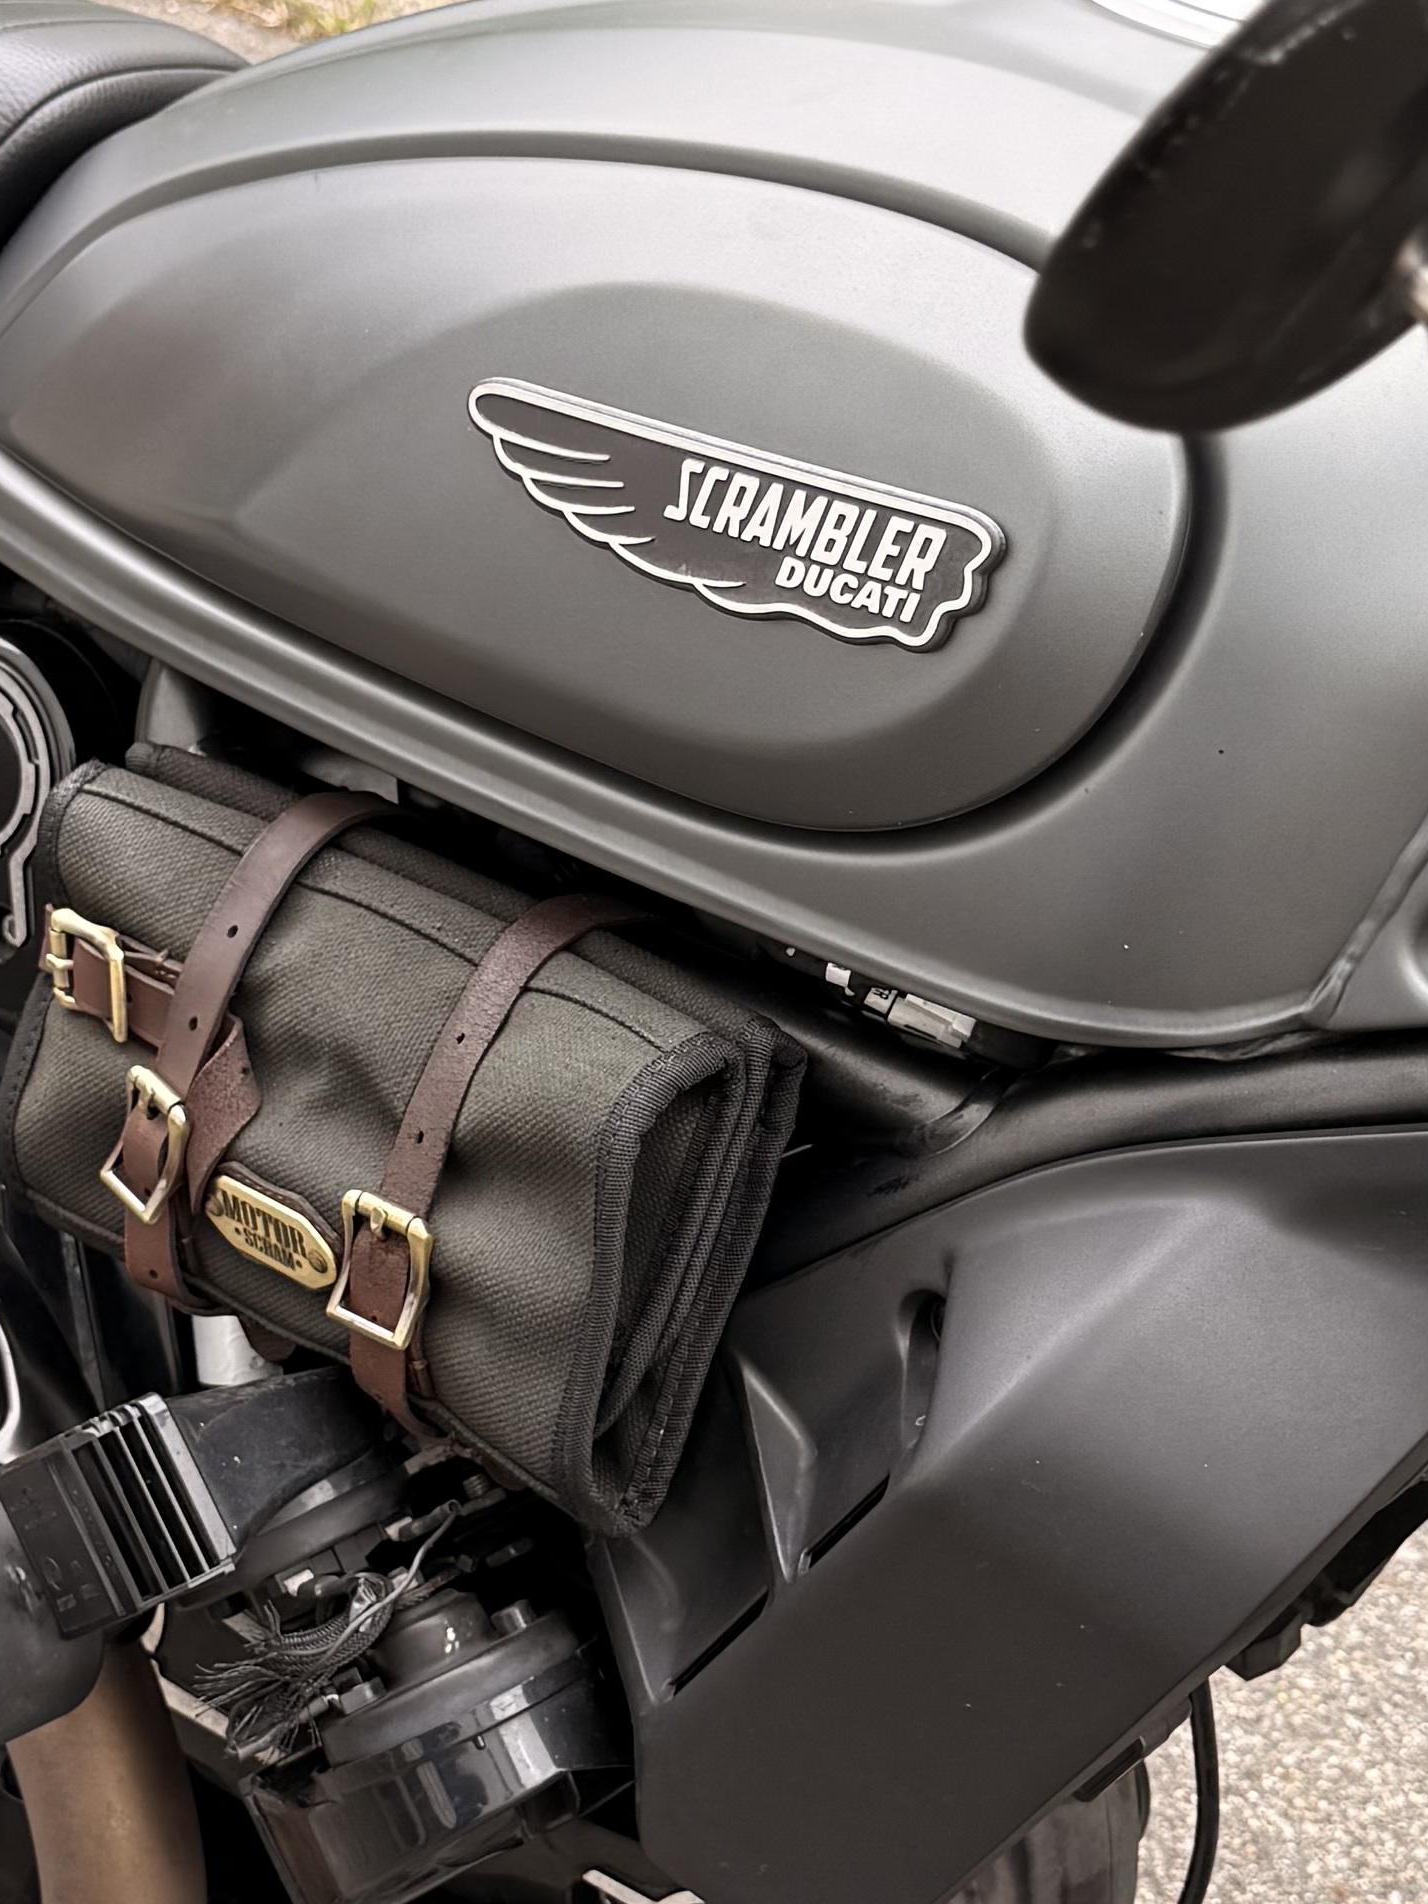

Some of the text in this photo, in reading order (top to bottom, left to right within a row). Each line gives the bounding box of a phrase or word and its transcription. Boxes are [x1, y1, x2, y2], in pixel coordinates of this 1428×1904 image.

[664, 458, 947, 591] SCRAMBLER
[775, 555, 920, 623] DUCATI
[221, 1188, 308, 1259] MOTOR
